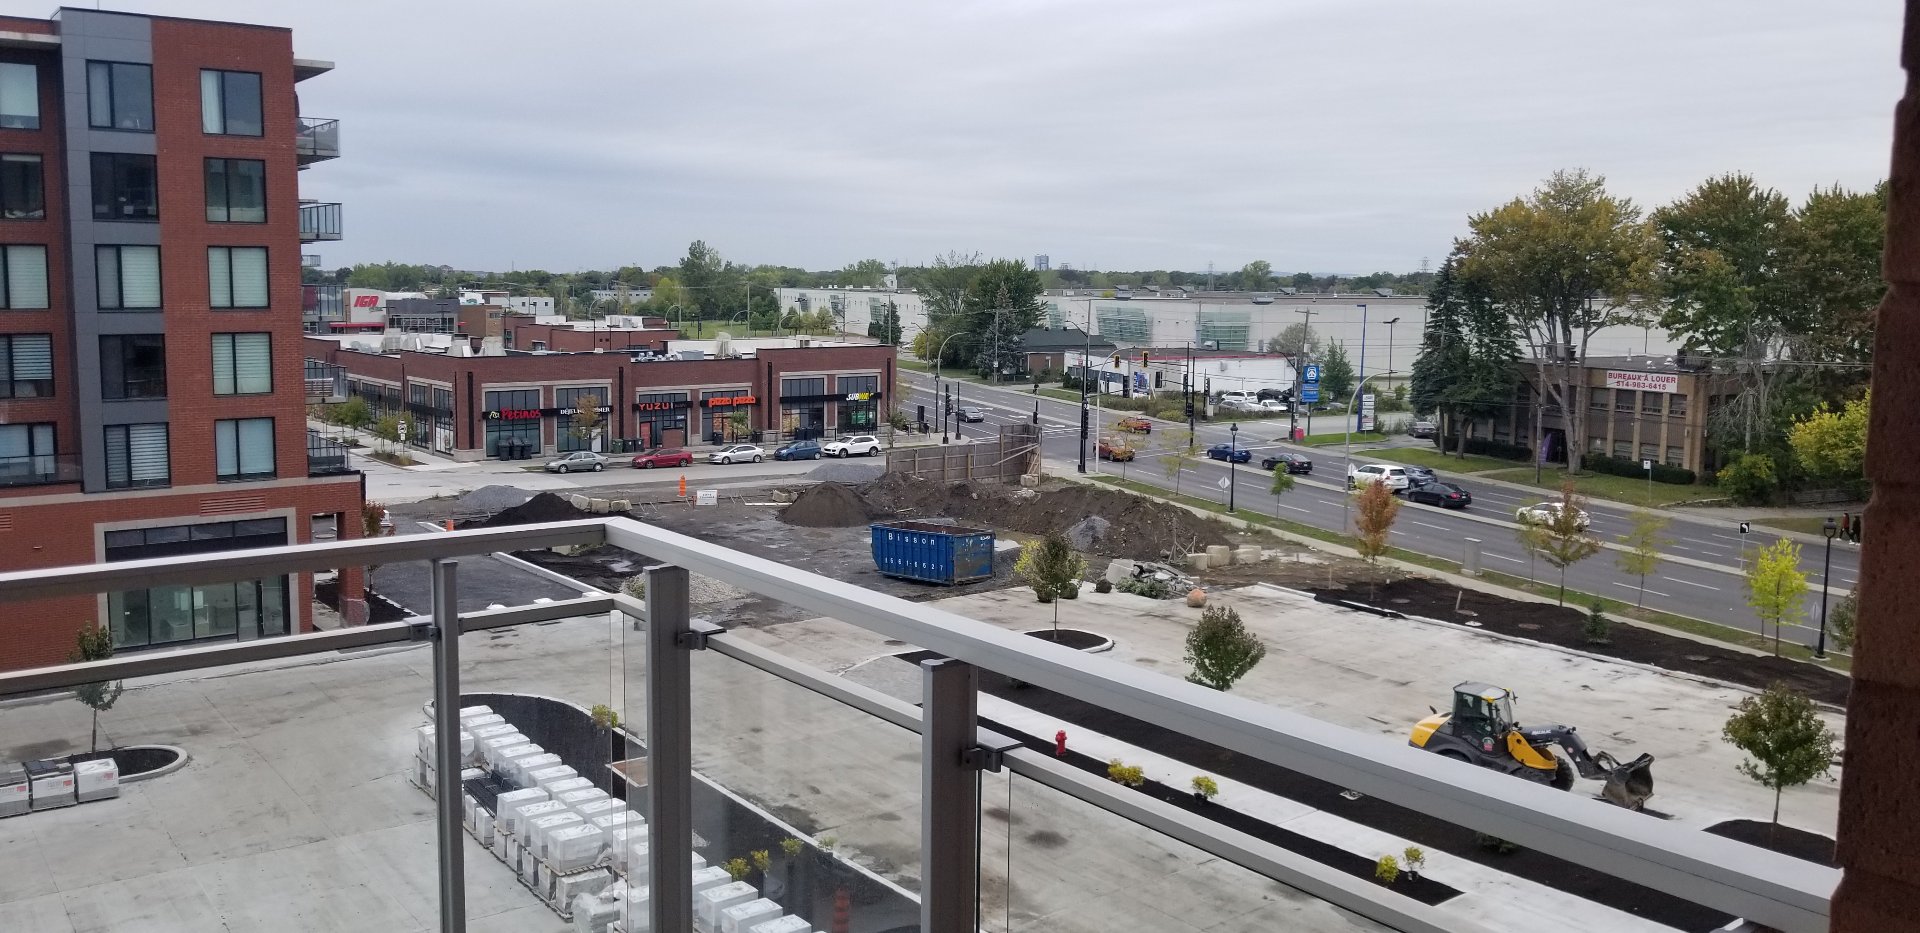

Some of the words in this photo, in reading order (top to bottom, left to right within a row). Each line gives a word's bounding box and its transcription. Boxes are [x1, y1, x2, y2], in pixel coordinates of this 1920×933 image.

[354, 295, 379, 307] IGA
[1608, 372, 1641, 381] BUREAUX
[1651, 375, 1676, 383] LOUER
[639, 402, 669, 411] YUZU
[709, 397, 731, 407] pizza
[733, 396, 755, 406] pizza
[888, 532, 934, 546] Bisson
